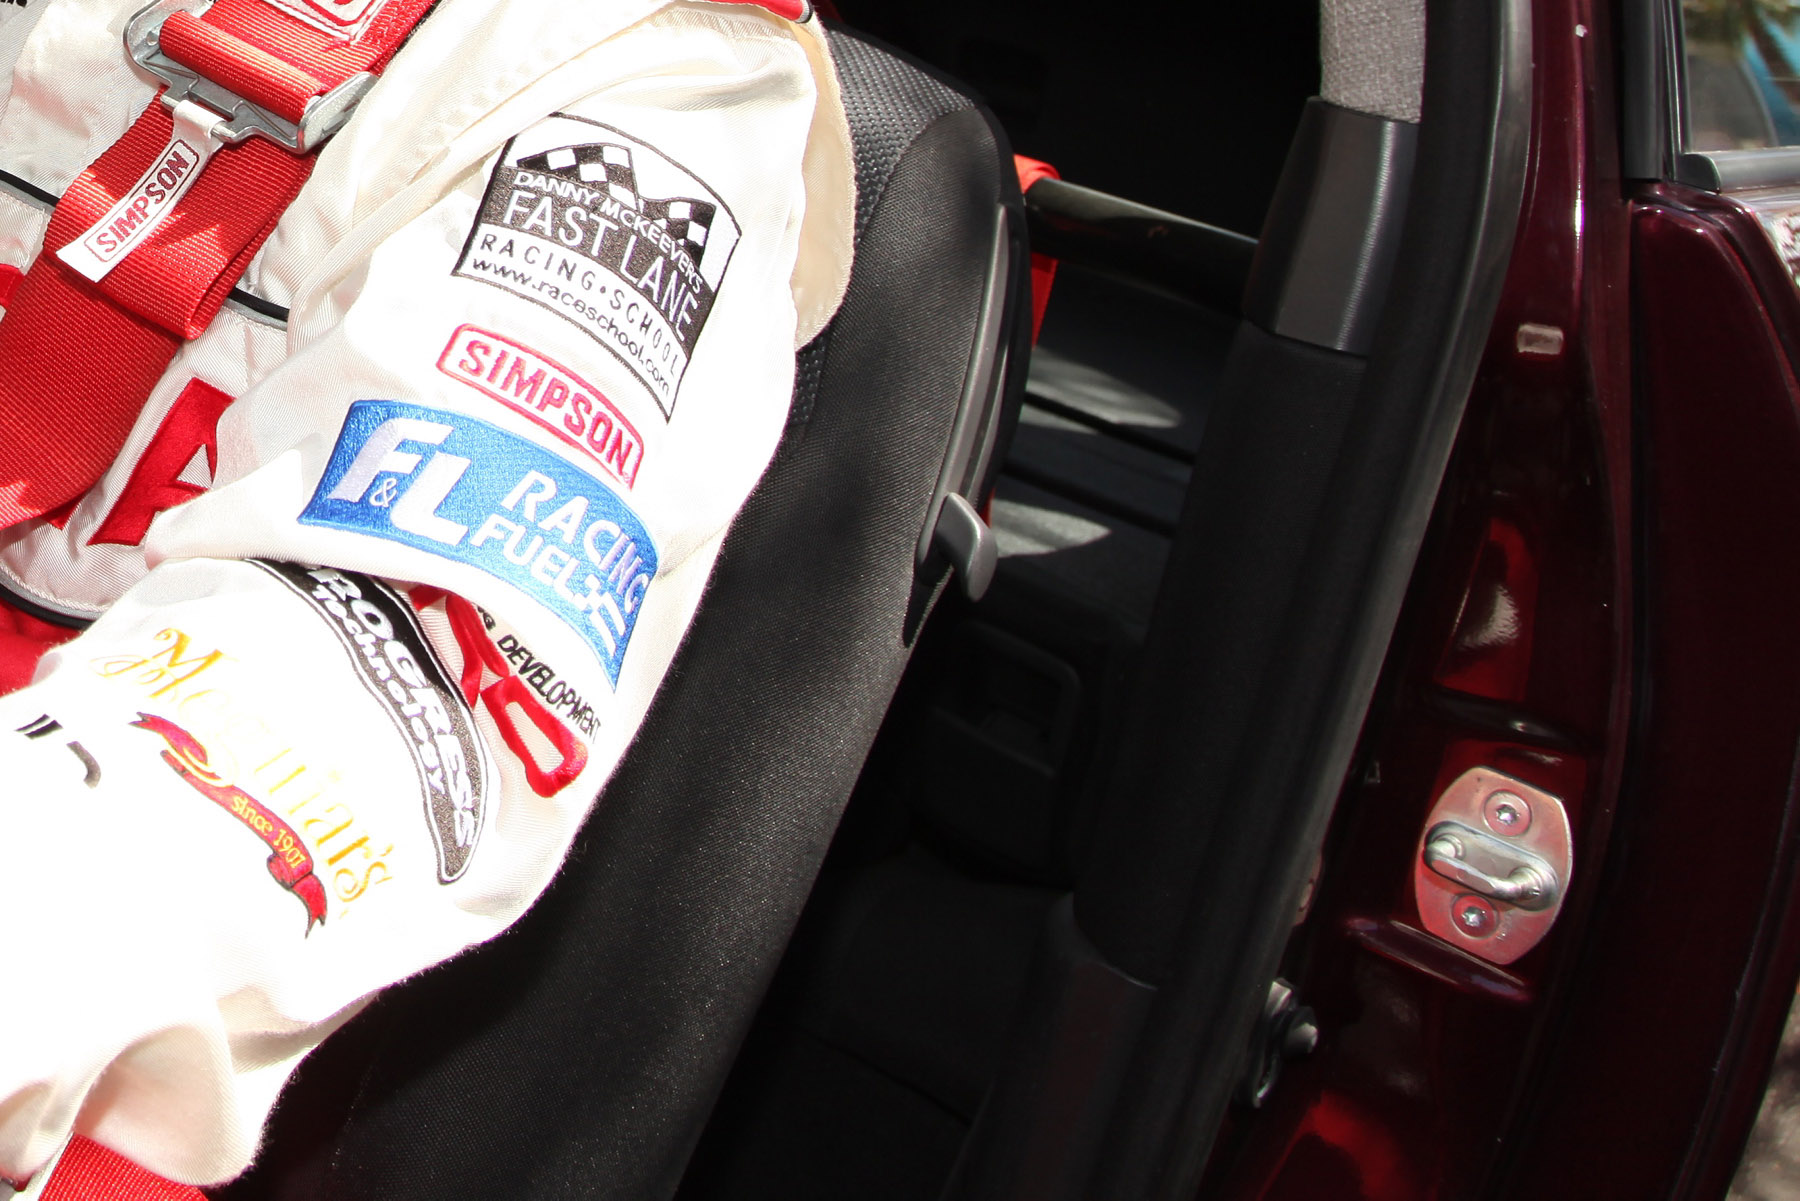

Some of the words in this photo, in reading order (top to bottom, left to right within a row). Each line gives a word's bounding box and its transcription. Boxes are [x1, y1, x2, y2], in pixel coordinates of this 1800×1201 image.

[96, 150, 189, 252] SIMPSON
[514, 171, 601, 205] DANNY
[472, 258, 670, 396] www.raceschool.com
[480, 232, 597, 291] RACING
[609, 288, 680, 377] SCHOOL
[502, 189, 619, 258] FAST
[619, 234, 698, 342] LANE
[458, 339, 633, 476] SIMPSON
[326, 417, 472, 546] F&L
[501, 469, 649, 615] RACING
[497, 633, 601, 744] DEVELOPMENT
[231, 795, 273, 836] since
[273, 828, 306, 868] 1901
